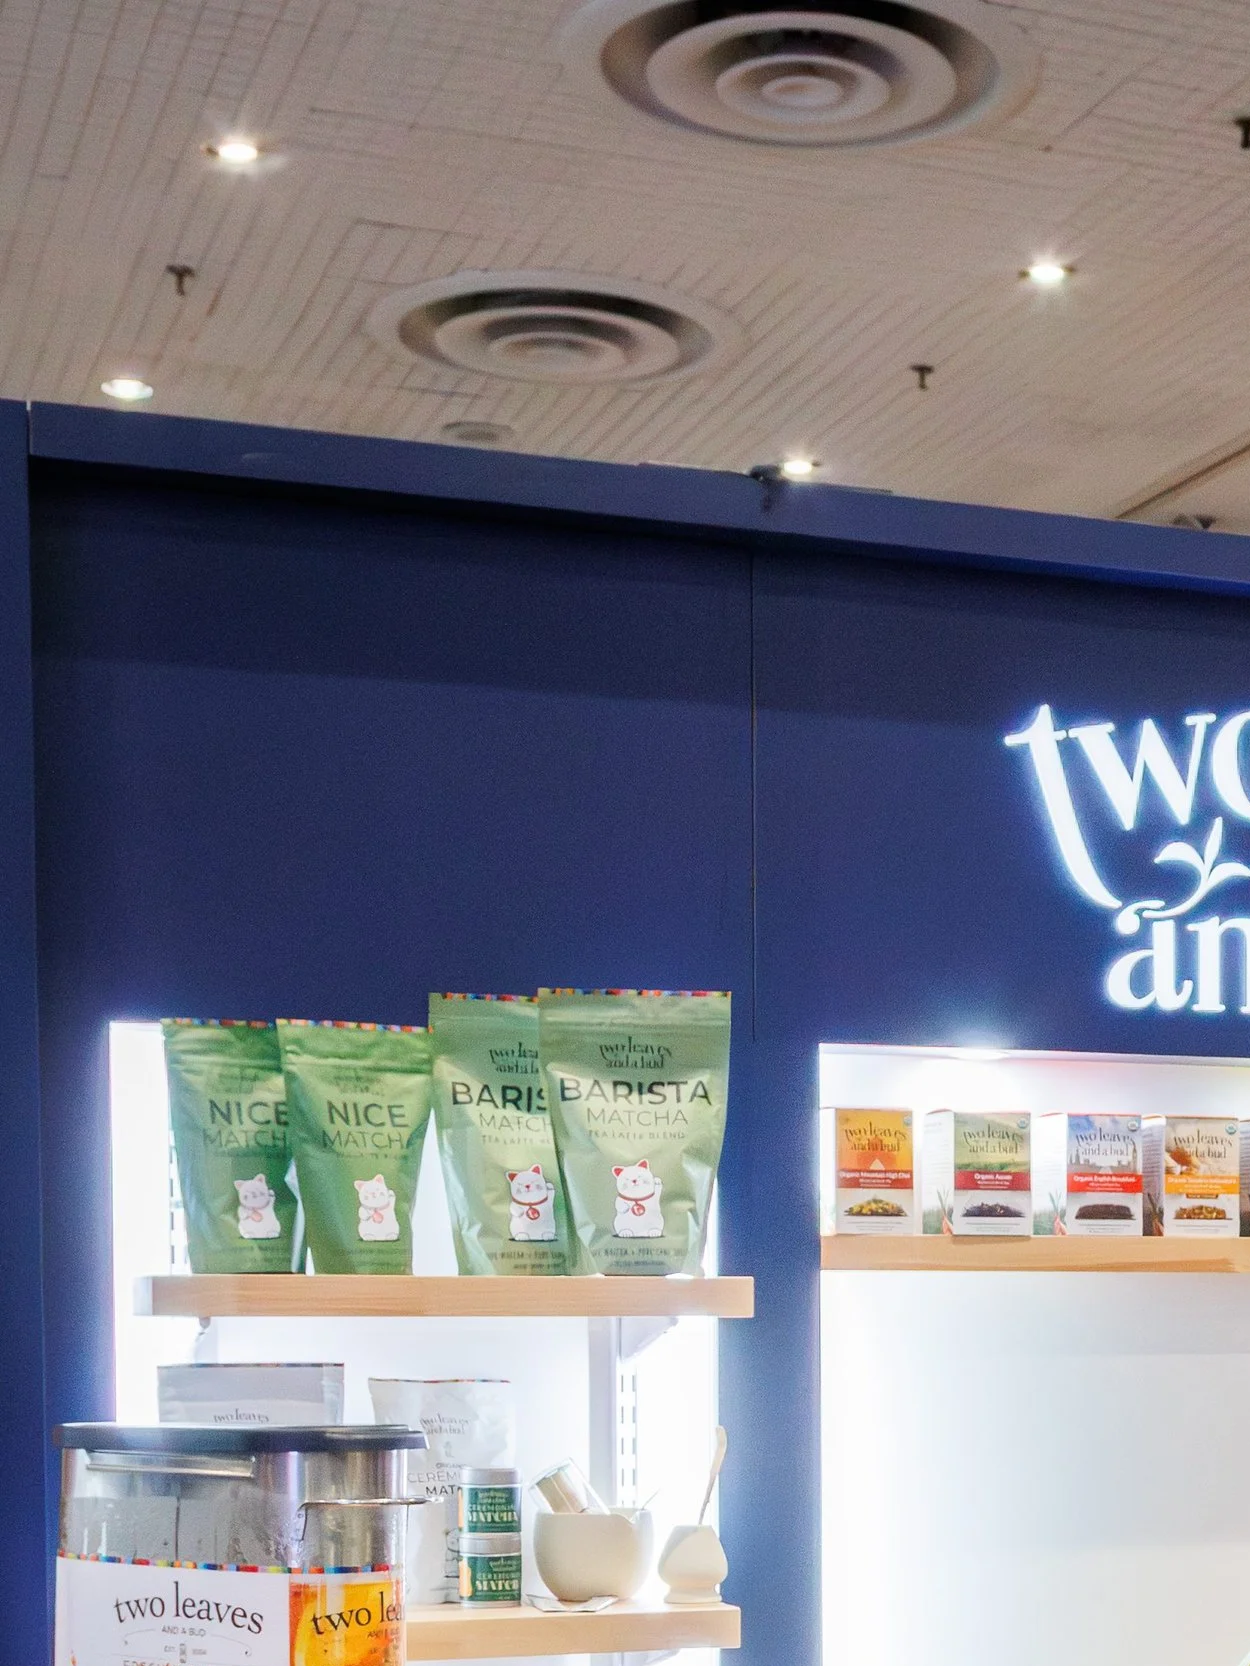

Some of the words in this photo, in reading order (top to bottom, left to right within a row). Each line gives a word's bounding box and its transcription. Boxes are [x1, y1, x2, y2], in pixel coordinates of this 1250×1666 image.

[560, 1076, 713, 1107] BARISTA
[208, 1099, 290, 1127] NICE
[326, 1099, 410, 1128] NICE
[586, 1107, 690, 1127] MATCHA
[202, 1127, 288, 1149] MATCH
[321, 1128, 406, 1149] MATCH
[407, 1471, 462, 1483] CEREM
[113, 1596, 166, 1624] two
[173, 1581, 265, 1634] leaves
[161, 1625, 179, 1635] AND
[188, 1627, 207, 1637] BUD
[311, 1607, 373, 1635] two
